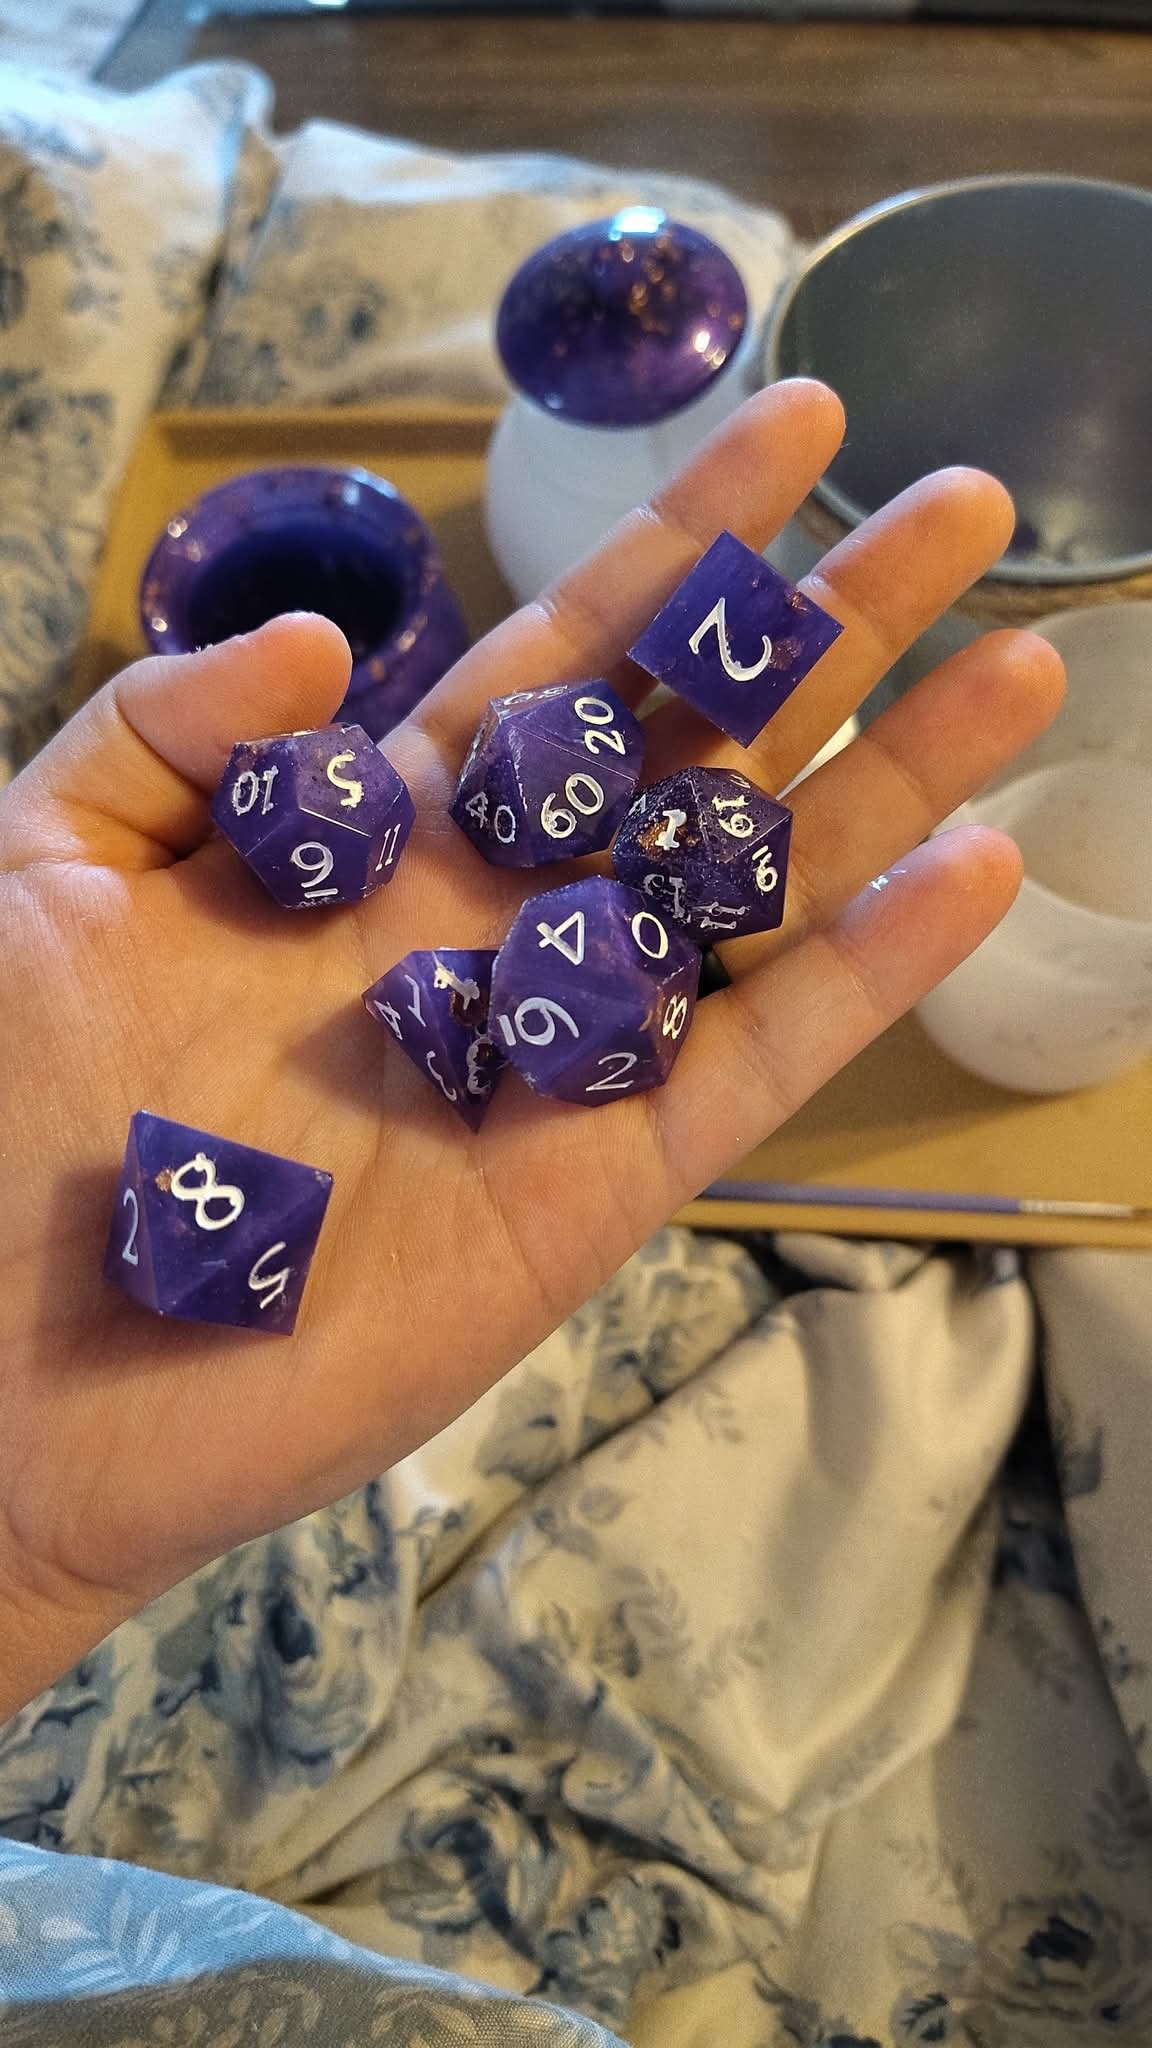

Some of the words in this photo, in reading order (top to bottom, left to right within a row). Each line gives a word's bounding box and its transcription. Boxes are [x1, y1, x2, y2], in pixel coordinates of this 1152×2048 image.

[688, 597, 772, 682] 2
[574, 696, 626, 756] 20
[232, 765, 279, 816] 10
[465, 791, 516, 844] 40
[541, 772, 605, 839] 60
[375, 823, 401, 871] 11
[537, 911, 585, 966] 4
[632, 911, 668, 959] 0
[662, 994, 688, 1040] 8
[586, 1052, 637, 1092] 2
[170, 1152, 245, 1231] 8
[122, 1188, 139, 1266] 2
